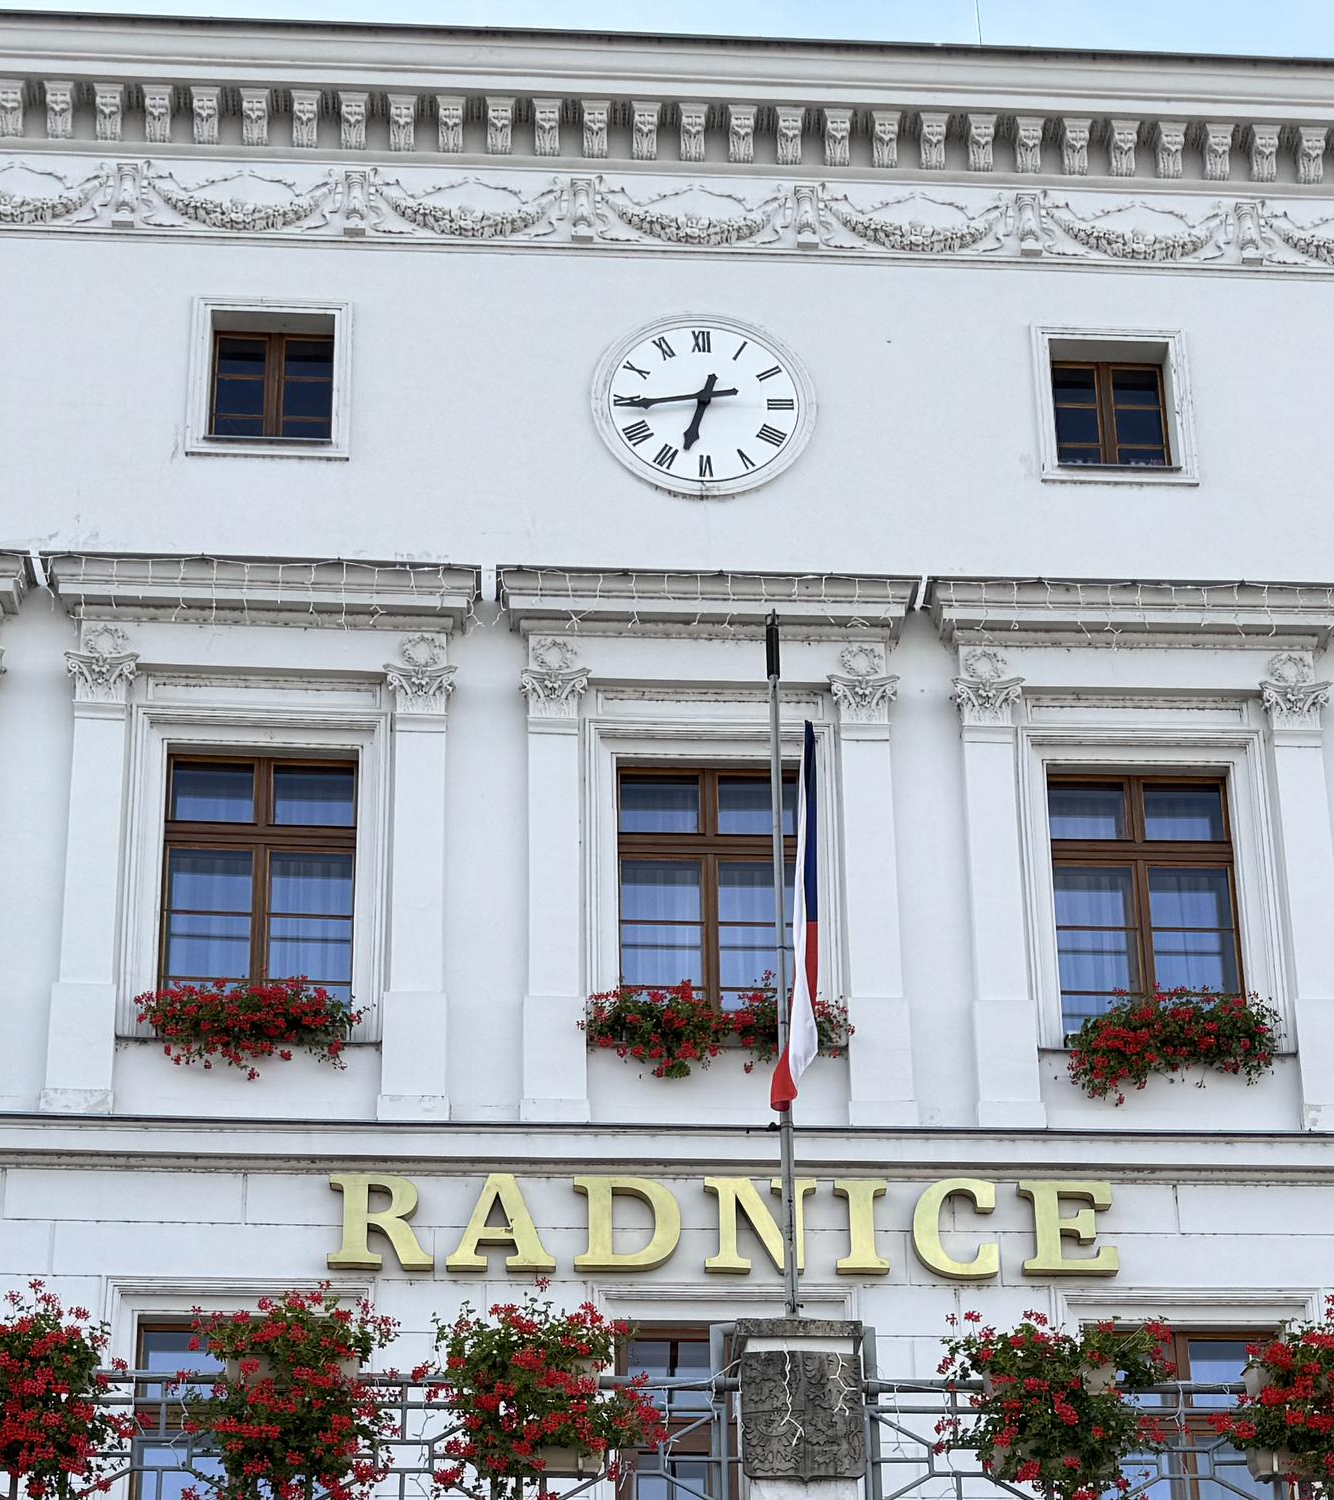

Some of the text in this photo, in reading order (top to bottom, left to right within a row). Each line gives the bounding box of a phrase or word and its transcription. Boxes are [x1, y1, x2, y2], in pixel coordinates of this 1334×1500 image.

[651, 336, 677, 361] XI
[691, 330, 712, 353] XII
[732, 340, 748, 361] I
[622, 360, 651, 380] X
[755, 365, 783, 382] II
[767, 398, 795, 410] III
[621, 419, 655, 447] VIII
[755, 423, 788, 448] IIII
[652, 443, 679, 470] VII
[699, 455, 713, 478] VI
[737, 448, 756, 470] V
[326, 1172, 1121, 1280] RADNICE
